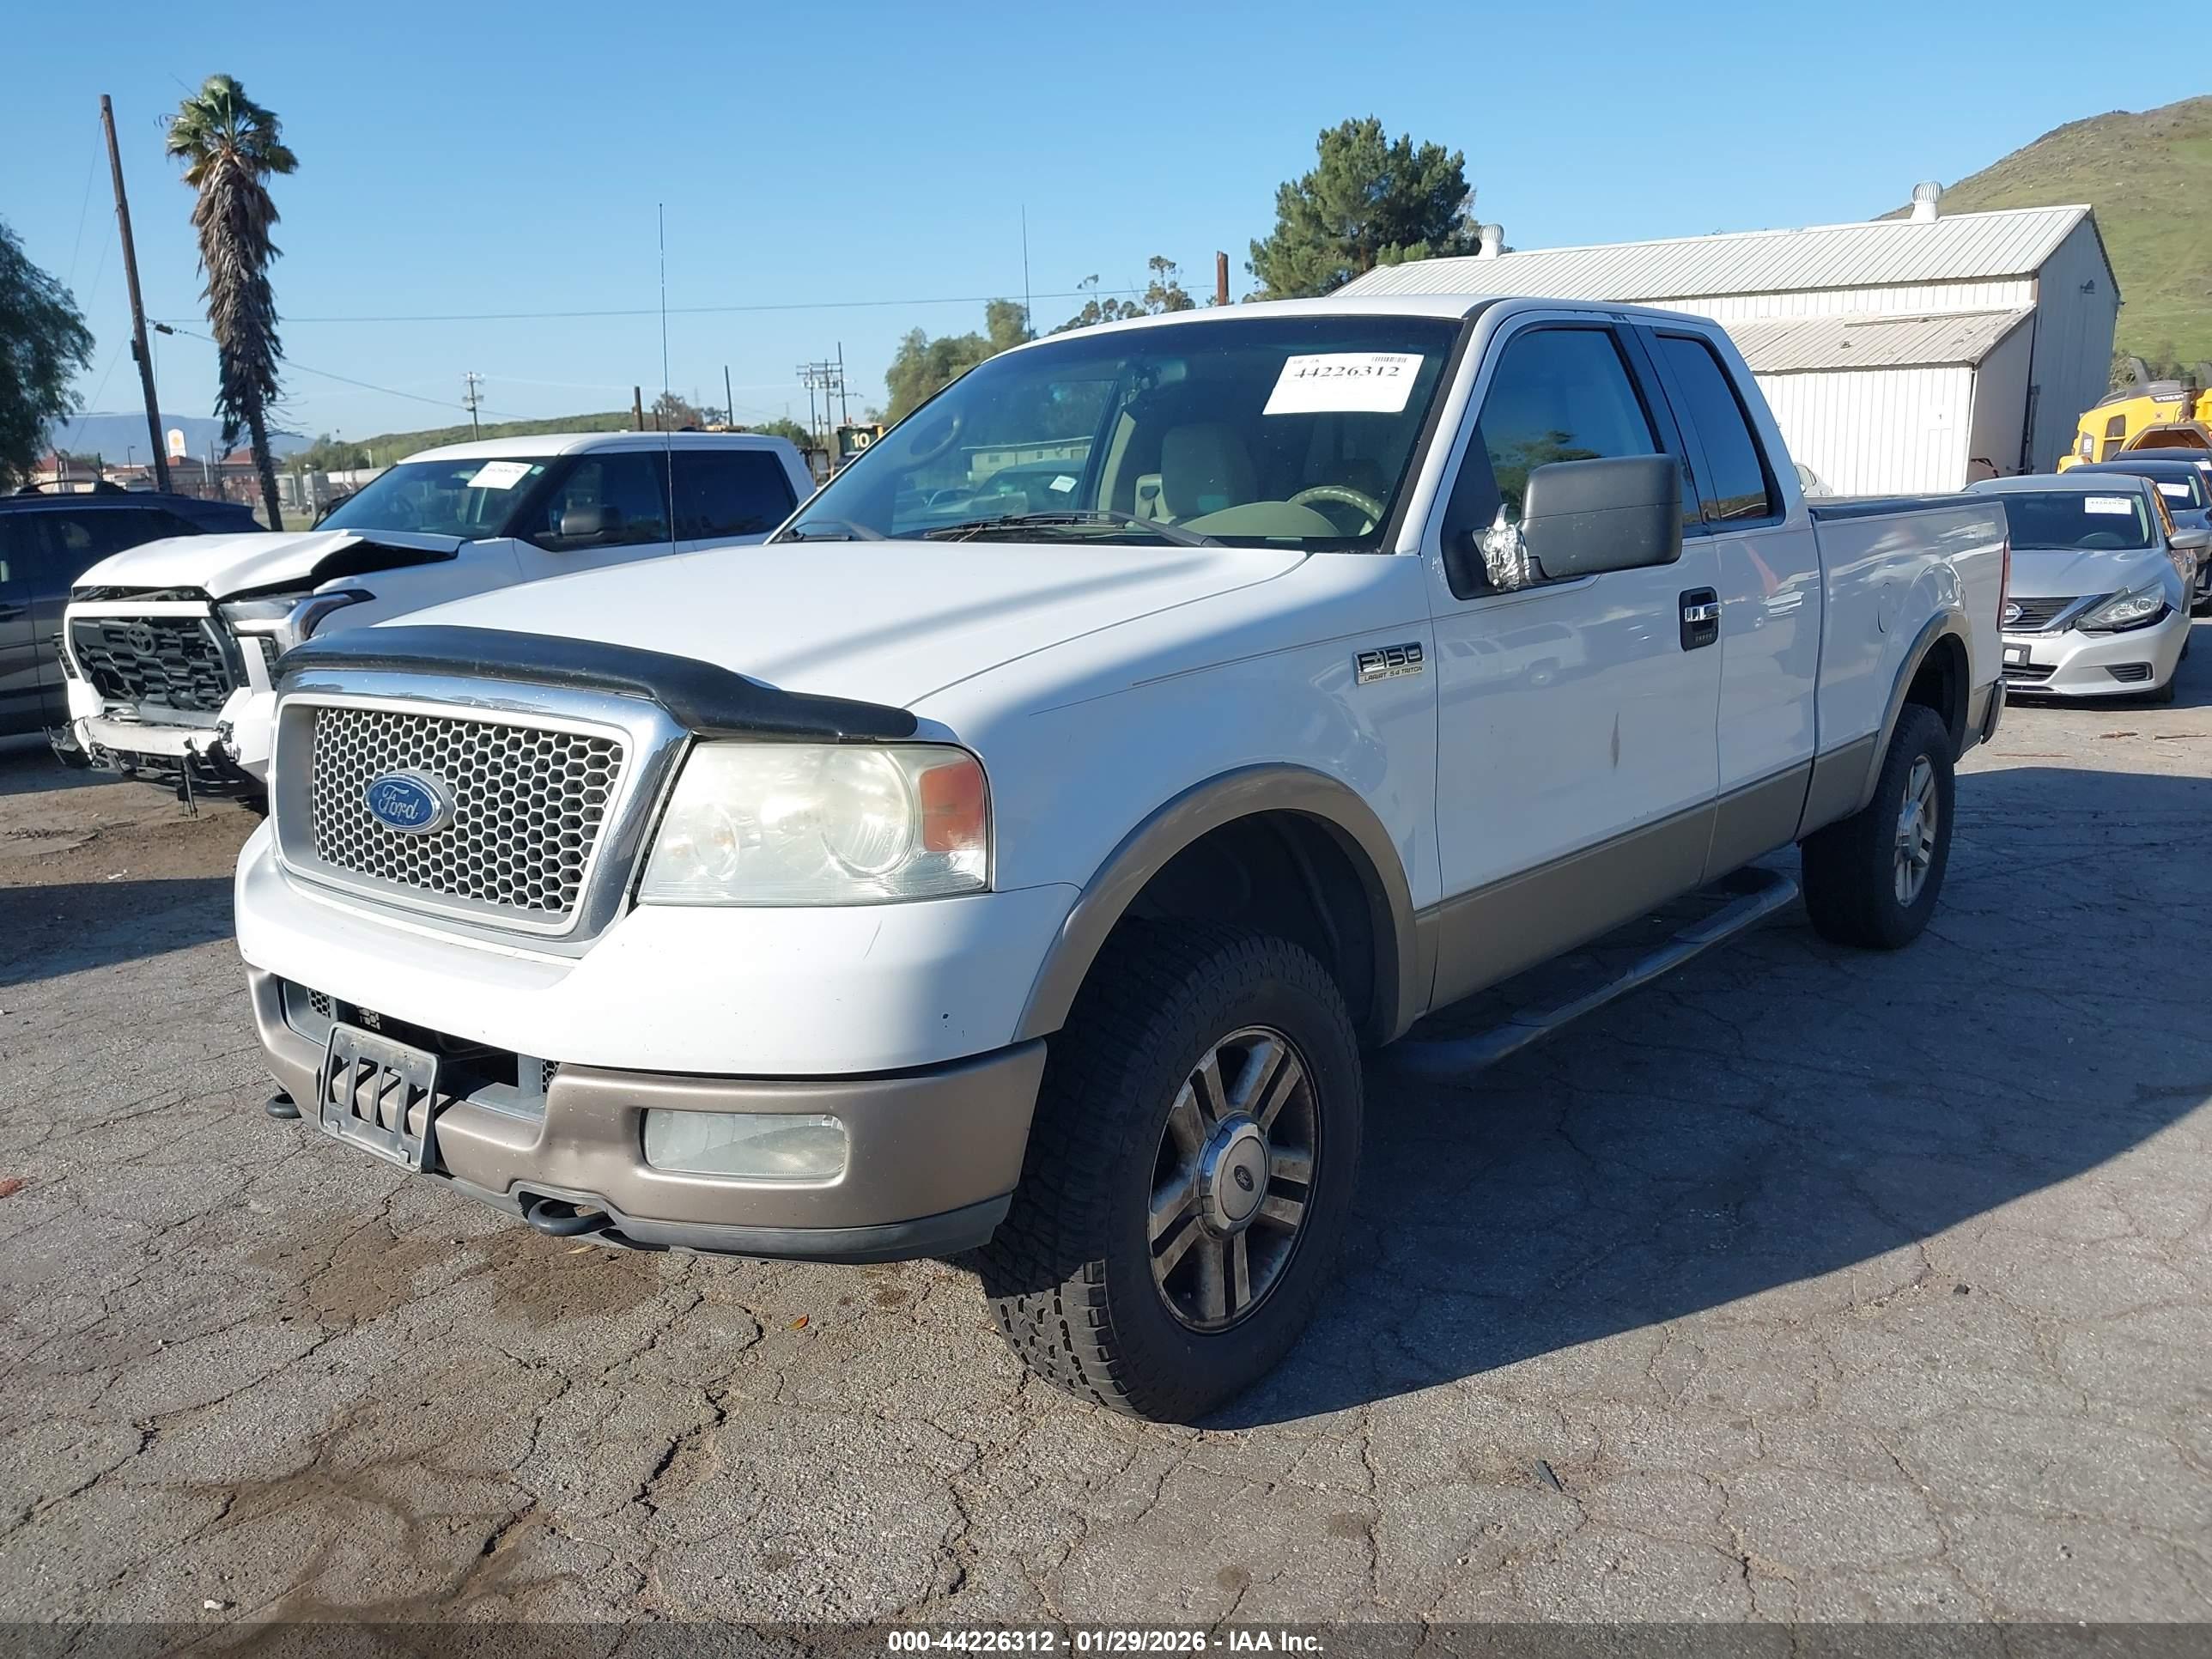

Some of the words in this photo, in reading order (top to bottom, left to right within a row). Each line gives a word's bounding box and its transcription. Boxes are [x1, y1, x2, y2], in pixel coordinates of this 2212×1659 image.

[1293, 365, 1401, 379] 44226312
[851, 432, 870, 448] 10
[1364, 672, 1387, 682] LARIAT
[1401, 665, 1423, 674] TRITON
[378, 784, 420, 821] Ford
